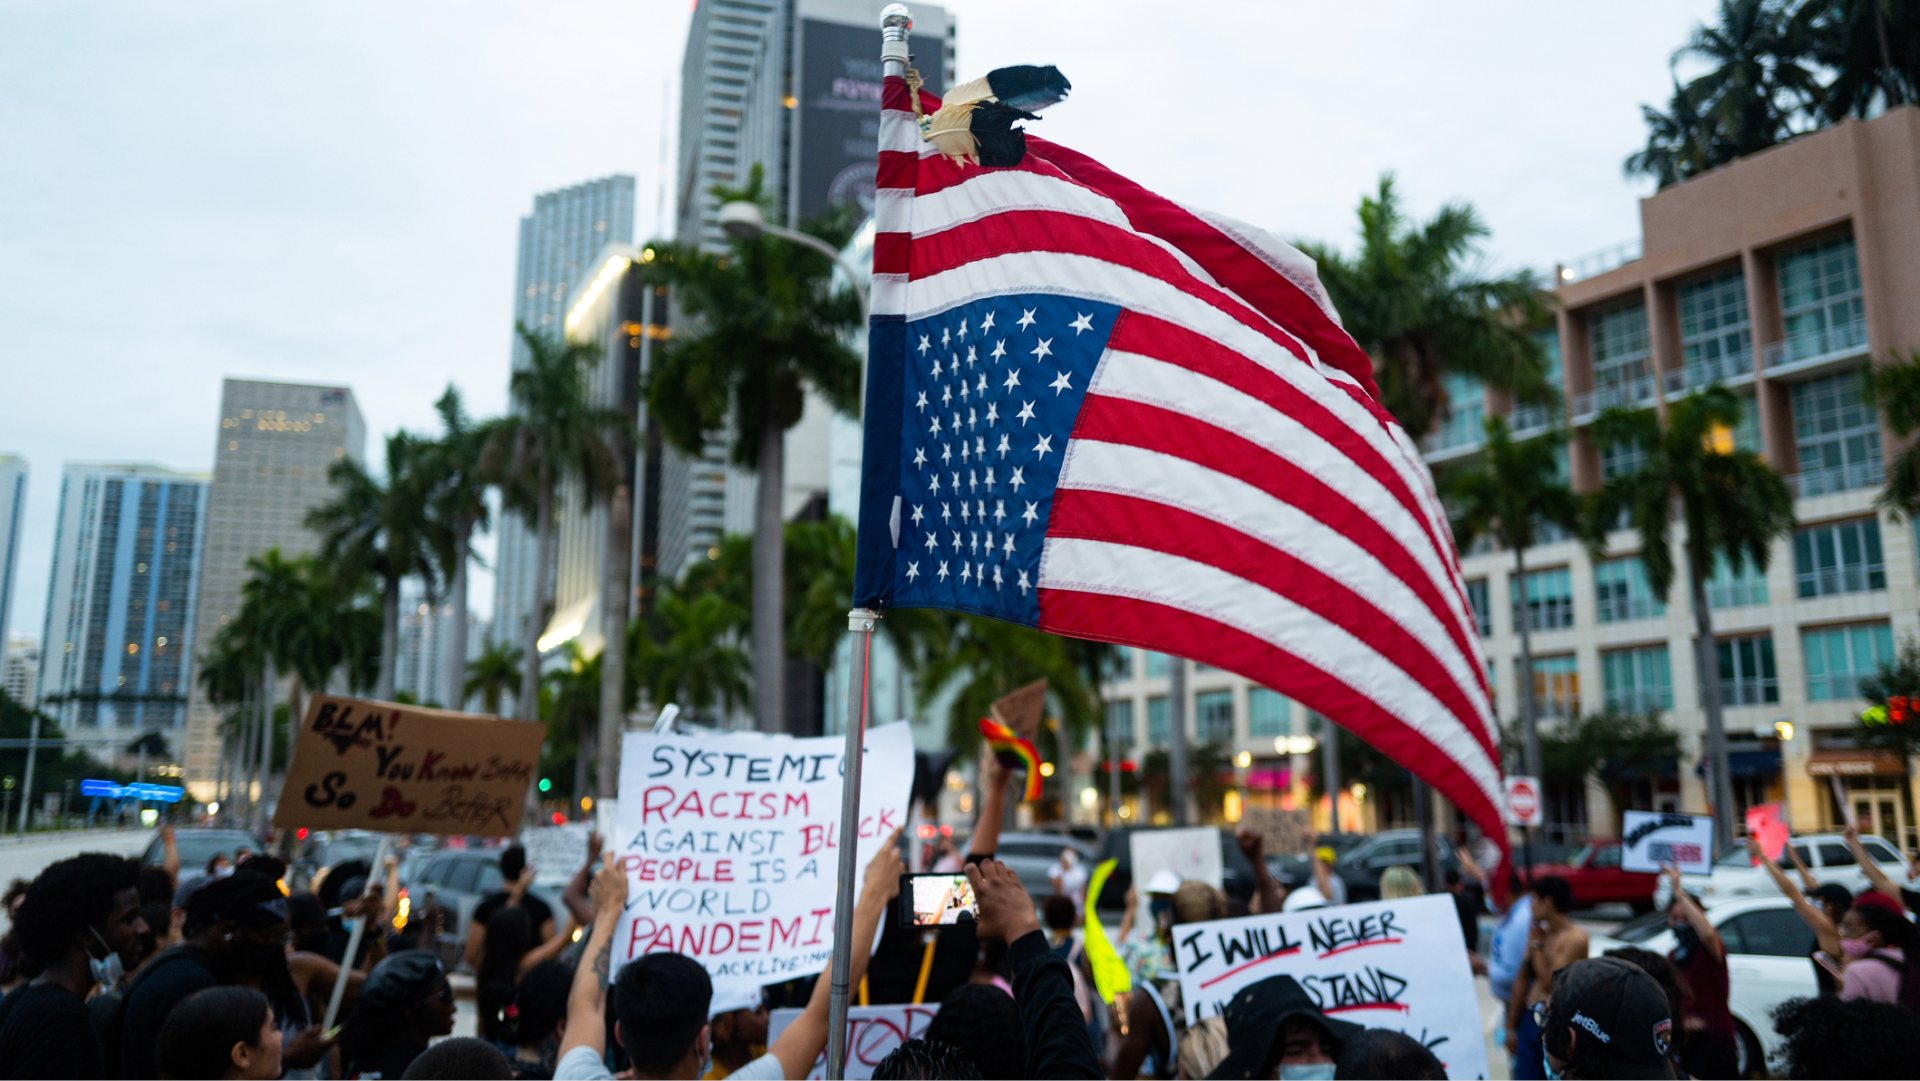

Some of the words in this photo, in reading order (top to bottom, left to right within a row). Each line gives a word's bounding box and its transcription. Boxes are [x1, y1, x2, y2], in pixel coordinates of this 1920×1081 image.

[312, 703, 402, 743] BLM!
[304, 770, 357, 810] So
[642, 785, 810, 825] RACISM
[627, 829, 784, 856] AGAINST
[799, 808, 896, 857] BLCK
[623, 855, 735, 883] PEOPLE
[748, 859, 787, 884] IS
[796, 858, 818, 880] A
[624, 888, 771, 915] WORLD
[628, 908, 835, 960] PANDEMI
[1181, 929, 1212, 973] I
[1218, 925, 1302, 966] WILL
[1308, 910, 1408, 952] NEVER
